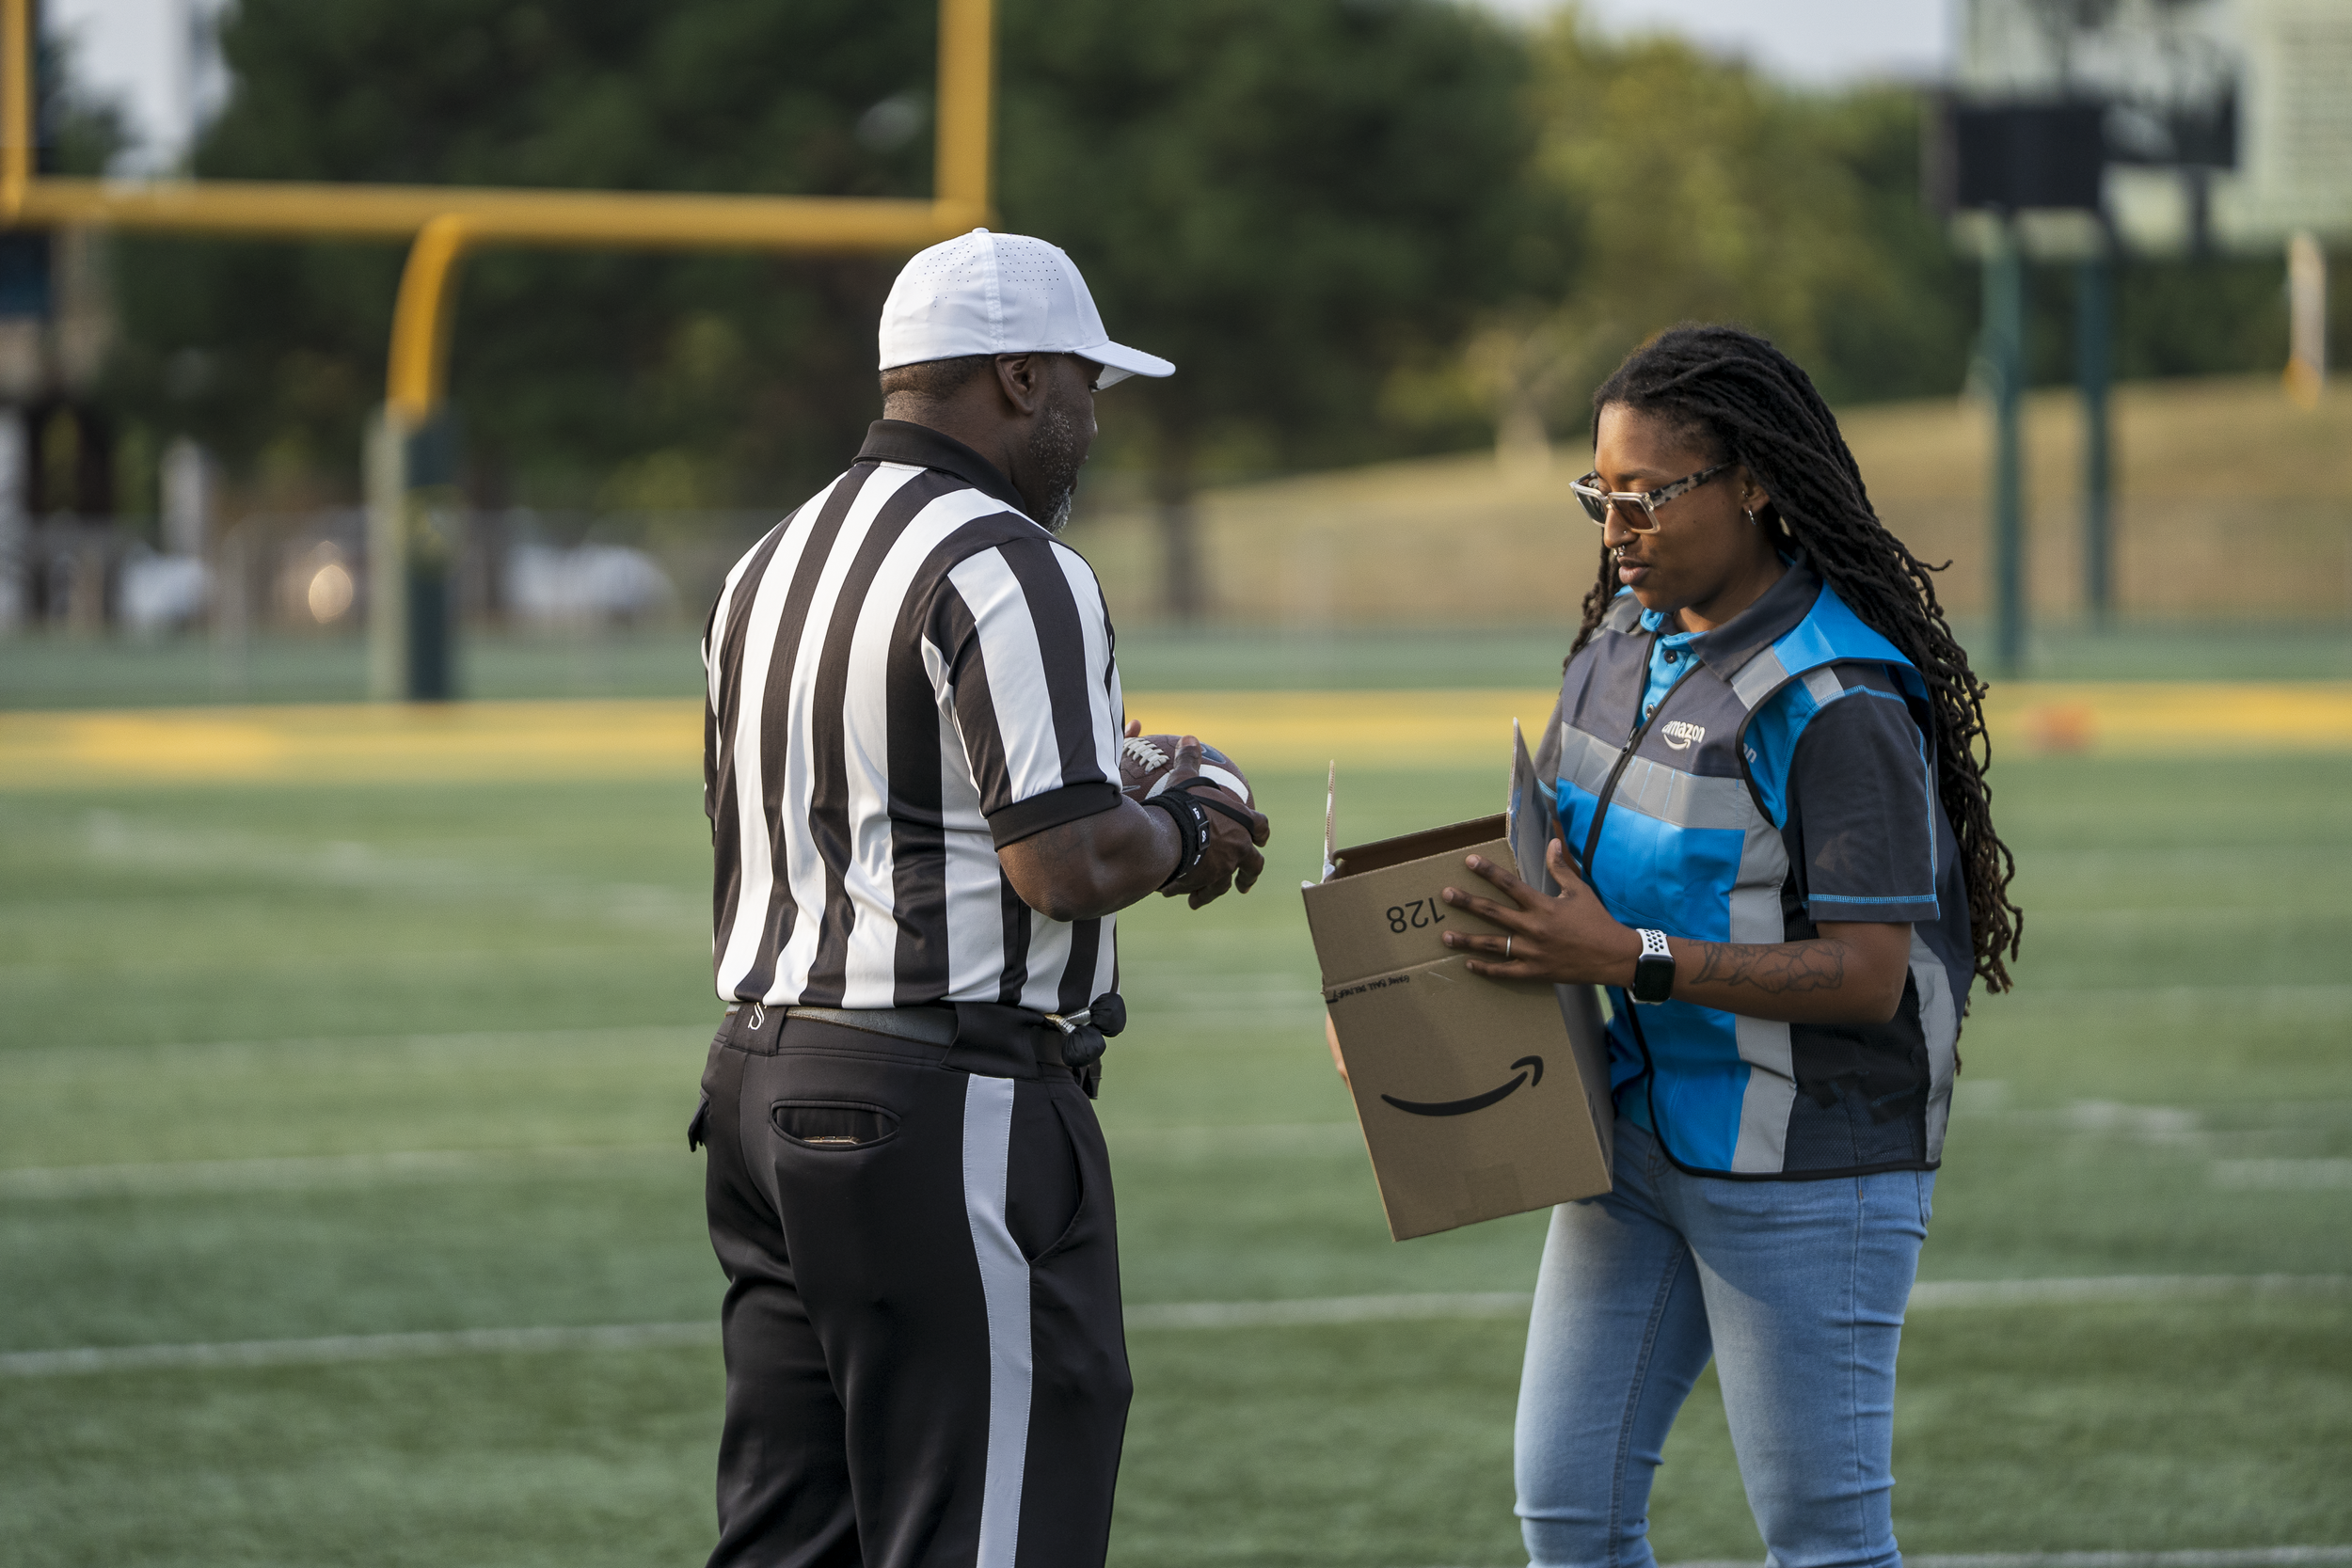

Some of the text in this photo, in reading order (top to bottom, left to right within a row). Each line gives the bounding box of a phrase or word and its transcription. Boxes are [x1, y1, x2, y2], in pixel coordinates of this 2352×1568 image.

[1661, 721, 1706, 743] amazon
[1386, 897, 1445, 933] 128
[1368, 979, 1388, 990] BALL
